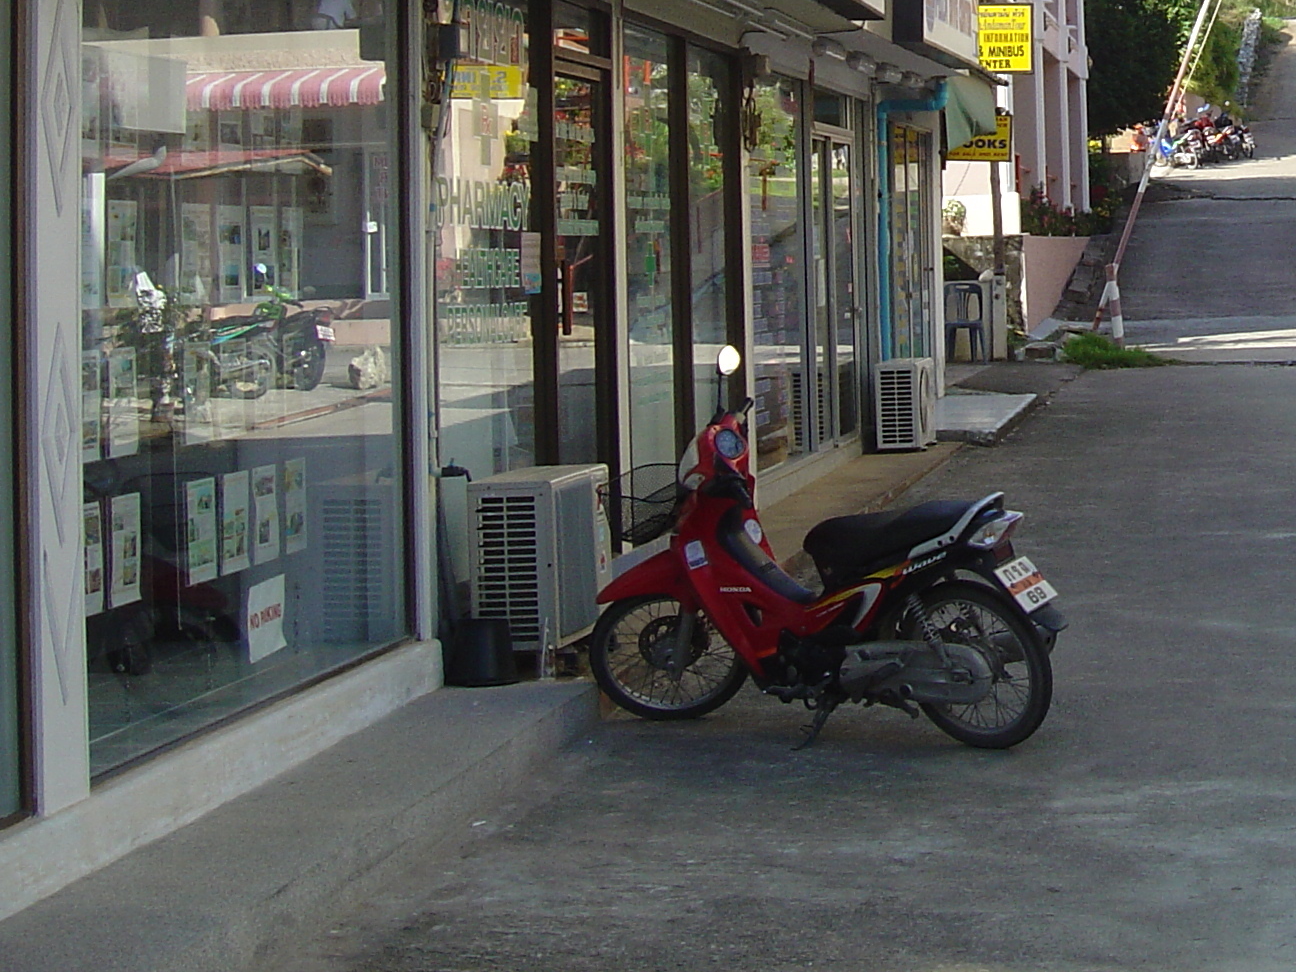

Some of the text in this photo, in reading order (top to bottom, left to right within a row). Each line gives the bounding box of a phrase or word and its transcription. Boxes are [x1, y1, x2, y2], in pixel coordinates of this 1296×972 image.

[984, 32, 1029, 43] INFORMATION
[988, 44, 1025, 58] MINIBUS
[436, 176, 531, 232] PHARMACY
[719, 585, 752, 593] HONDA
